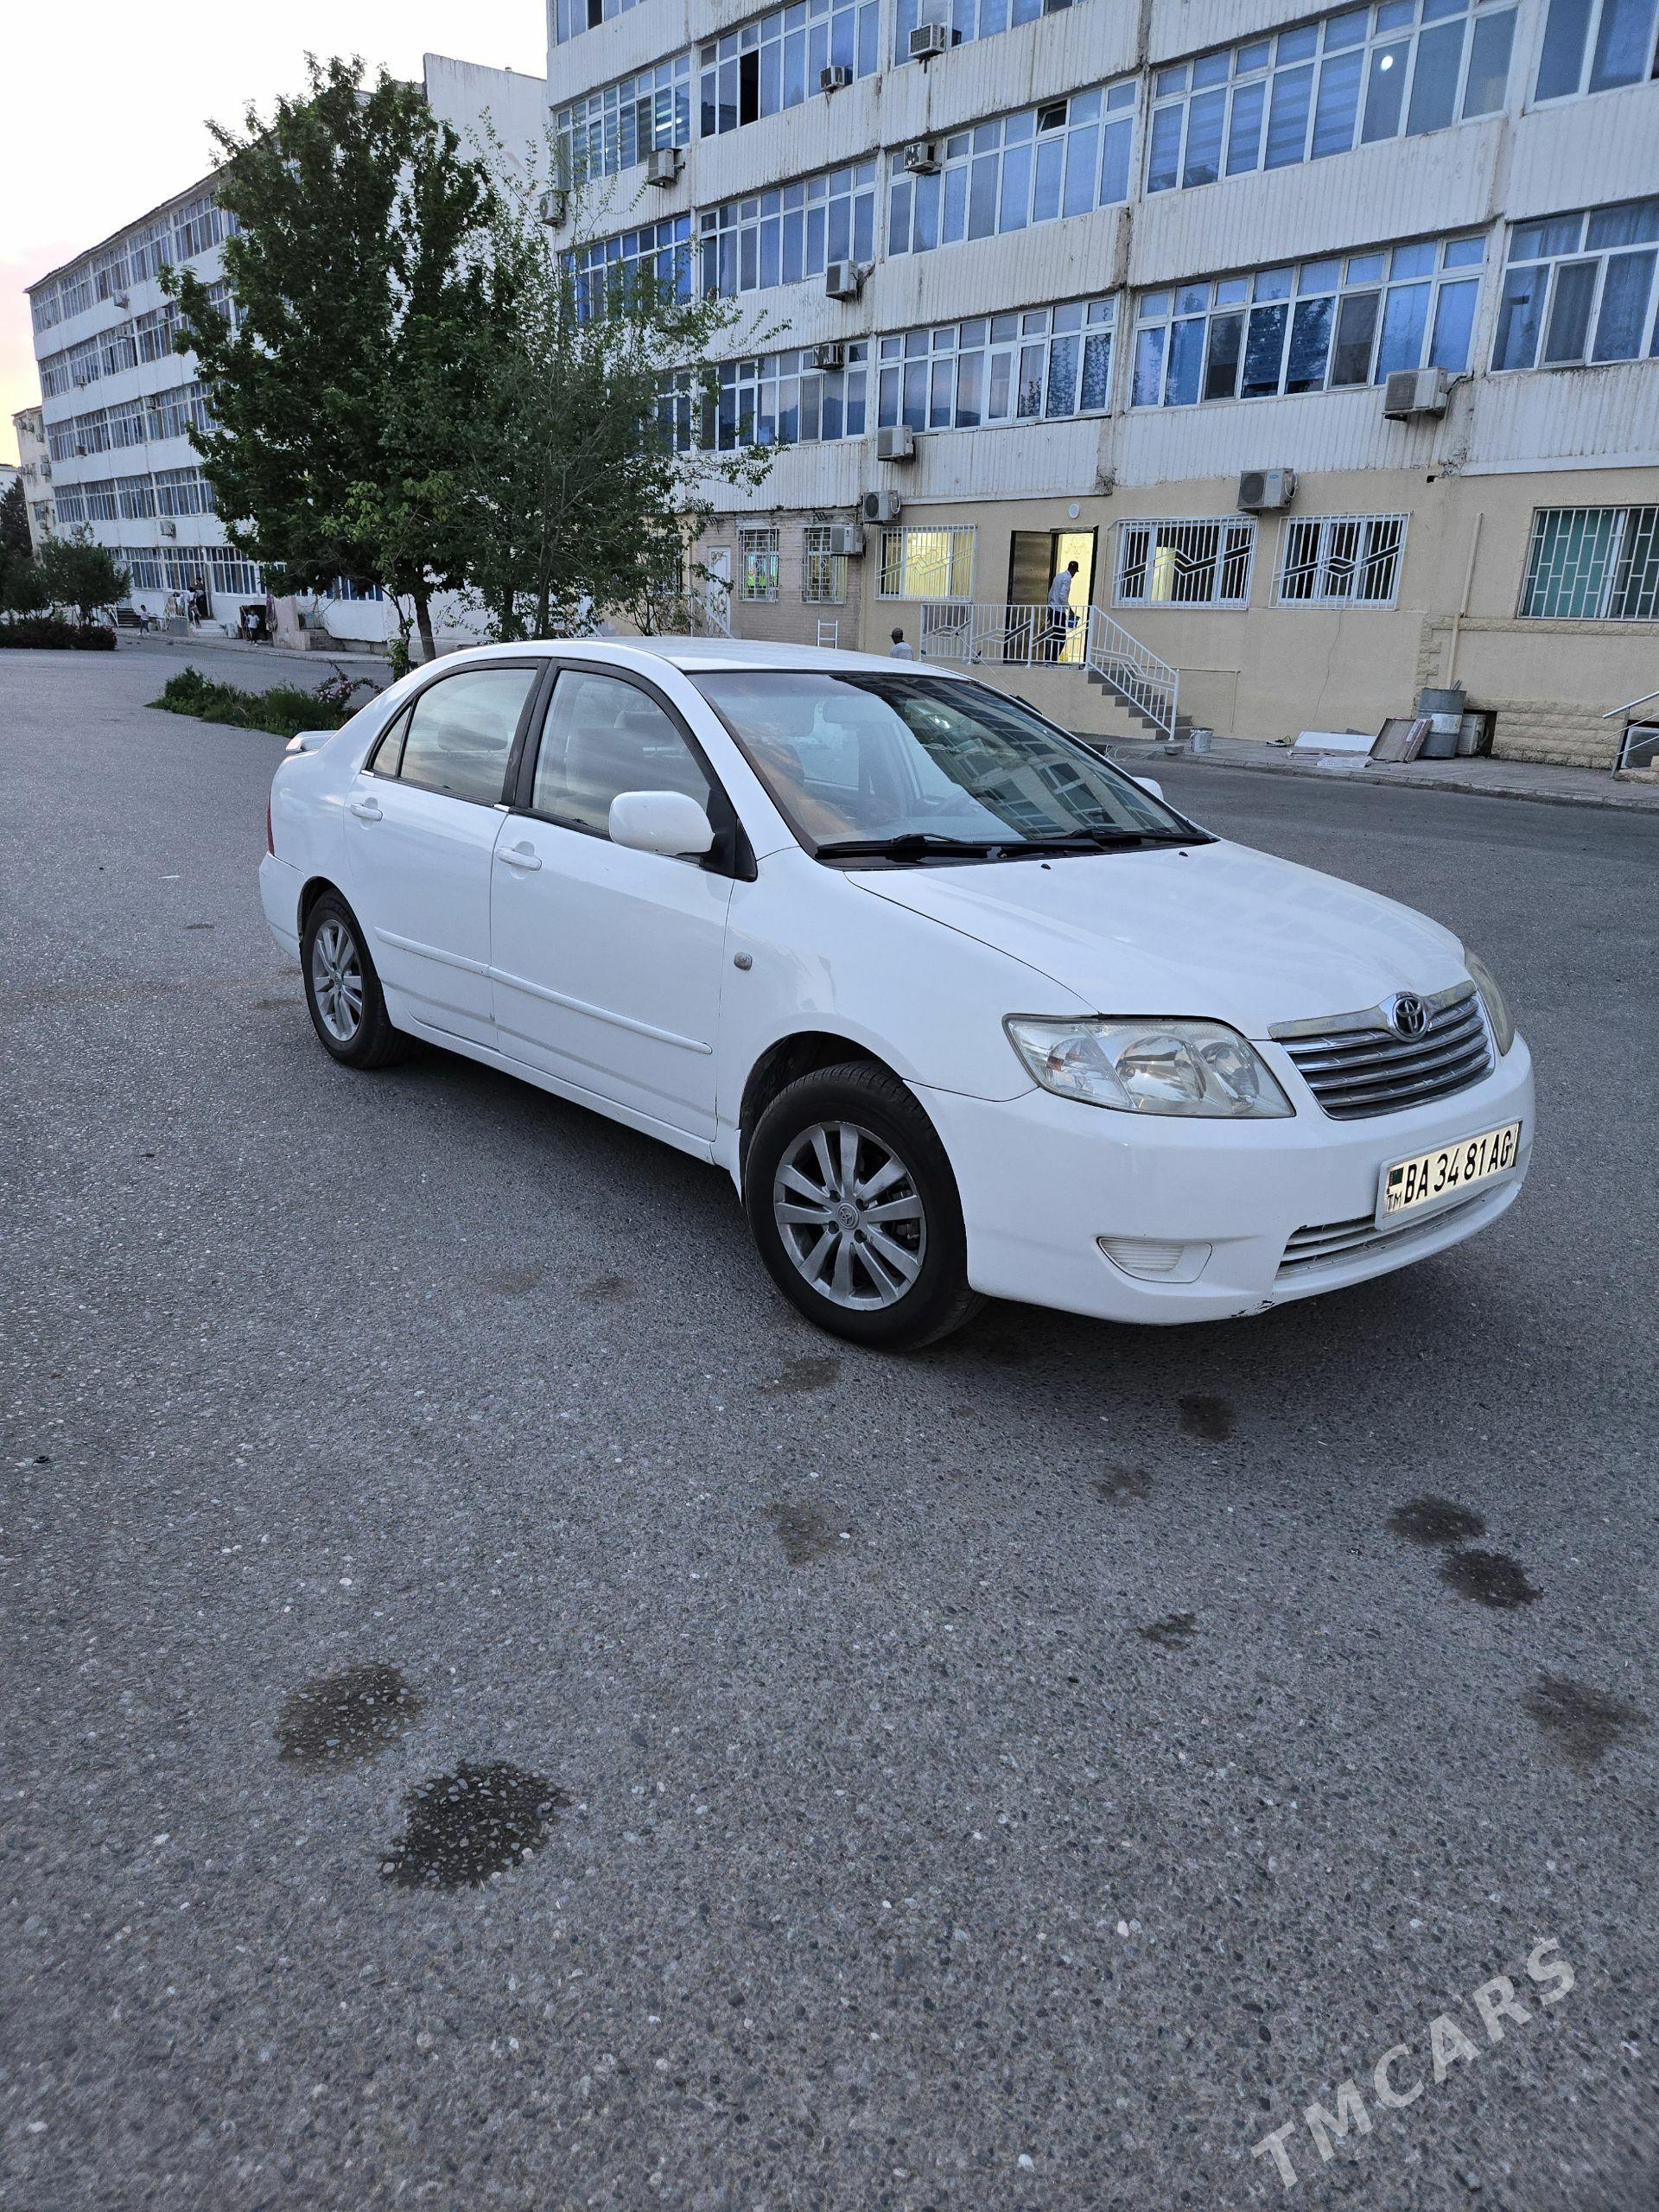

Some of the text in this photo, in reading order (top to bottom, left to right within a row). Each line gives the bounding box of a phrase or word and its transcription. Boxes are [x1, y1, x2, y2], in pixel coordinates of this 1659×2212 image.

[1404, 1159, 1428, 1204] BA
[1487, 1130, 1511, 1173] AG
[1387, 1191, 1402, 1211] TM
